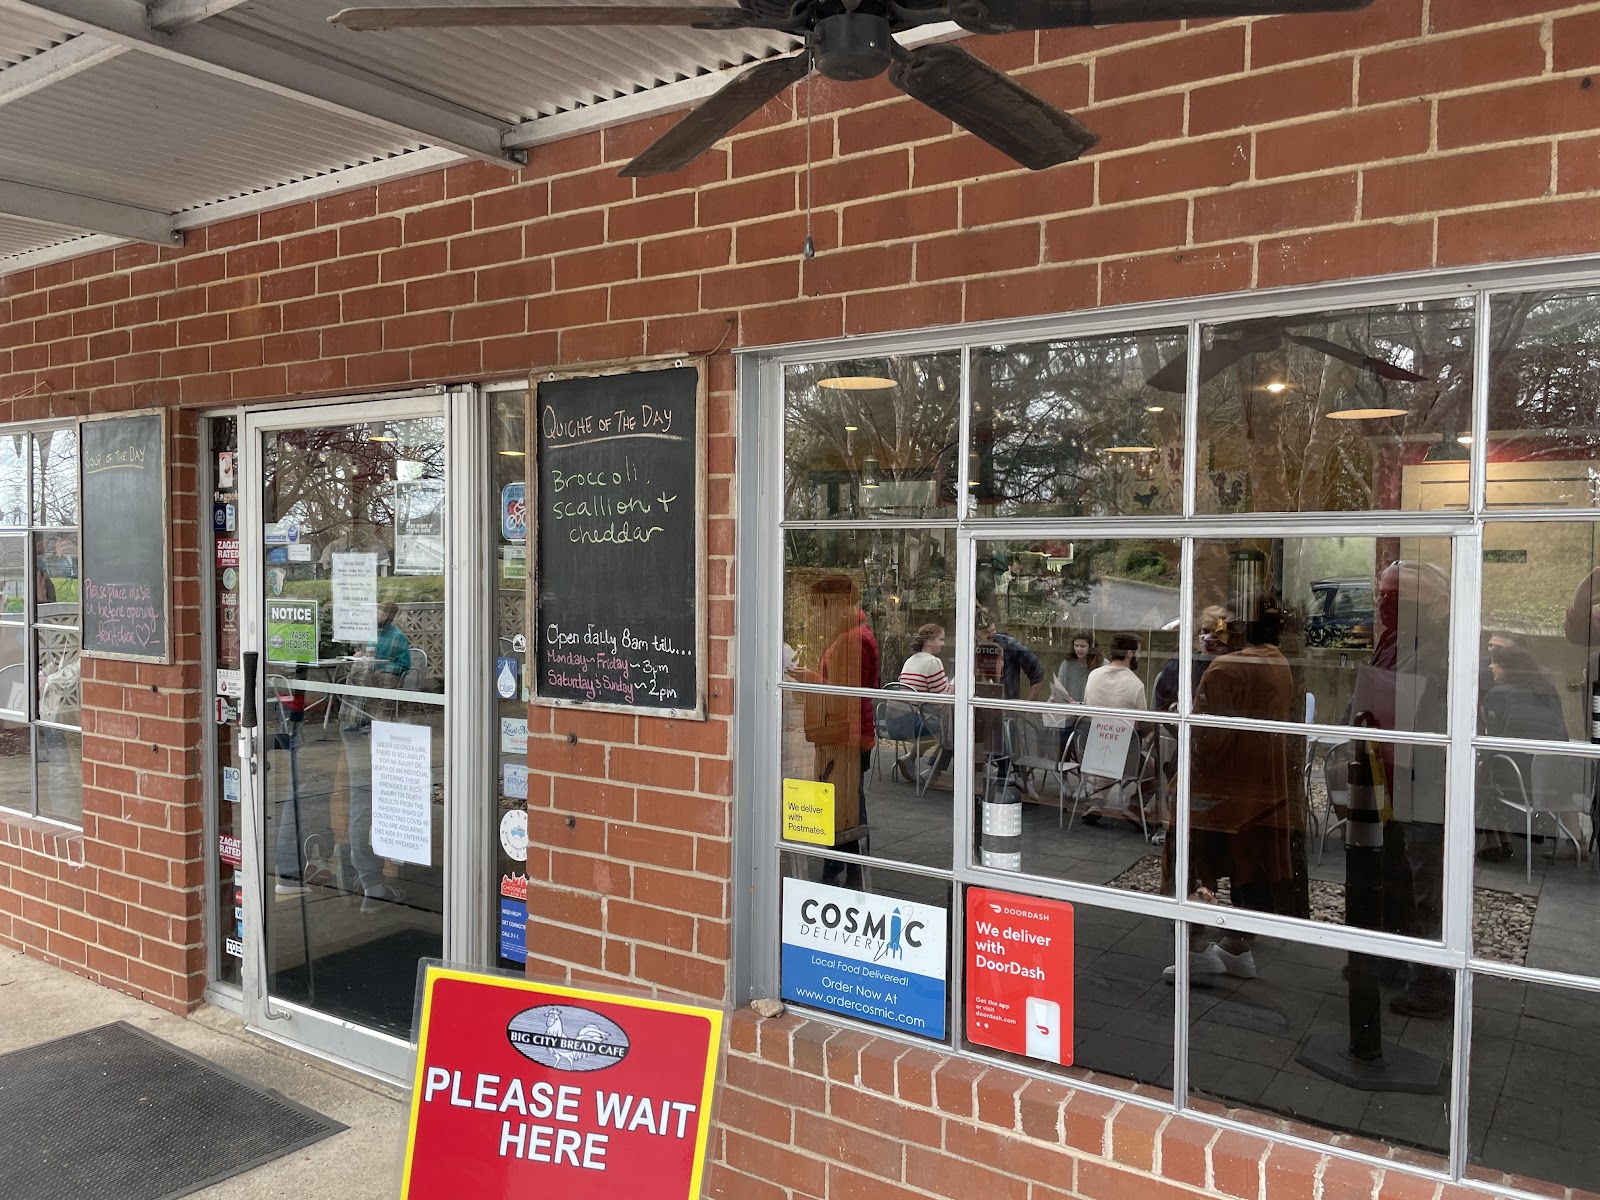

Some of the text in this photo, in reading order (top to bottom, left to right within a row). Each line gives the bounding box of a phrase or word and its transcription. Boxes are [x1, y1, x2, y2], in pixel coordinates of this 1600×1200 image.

[543, 404, 672, 438] QUICHE OF THE DAY
[84, 446, 146, 468] SOUP OF THE DAY
[552, 495, 650, 520] scallion
[570, 521, 664, 544] cheddar
[217, 541, 240, 549] ZAGAT
[217, 550, 240, 558] RATED
[84, 578, 106, 600] Please
[271, 607, 312, 620] NOTICE
[290, 631, 310, 641] MASKS
[546, 624, 580, 650] Open
[285, 639, 314, 650] REQUIRED
[498, 660, 515, 669] 2017
[642, 660, 669, 680] 3pm
[500, 682, 514, 692] blue
[548, 670, 596, 700] Saturday
[602, 675, 634, 704] Sunday
[648, 679, 678, 702] 2pm
[504, 723, 517, 736] Local
[1096, 723, 1114, 731] PICK
[1099, 732, 1120, 740] HERE
[381, 774, 404, 782] ENTERING
[403, 769, 429, 778] INDIVIDUAL
[380, 782, 403, 790] PREMISES
[378, 797, 399, 805] RESULTS
[378, 805, 401, 813] INHERENT
[788, 802, 823, 814] We deliver
[373, 812, 405, 823] CONTRACTING
[788, 813, 803, 822] with
[399, 825, 423, 834] ASSUMING
[788, 823, 826, 836] Postmates.
[219, 836, 241, 847] ZAGAT
[380, 837, 394, 845] THESE
[404, 834, 428, 843] ENTERING
[219, 845, 241, 857] RATED
[1004, 907, 1049, 921] DOORDASH
[509, 921, 526, 930] CONNECTE
[801, 899, 925, 952] COSMIC
[975, 920, 1051, 947] We deliver
[800, 924, 886, 961] DELIVERY
[975, 940, 1005, 955] with
[811, 955, 909, 986] Local Food Delivered!
[976, 954, 1045, 981] DoorDash
[821, 977, 897, 1005] Order Now At
[976, 996, 987, 1004] Get
[796, 987, 925, 1029] www.ordercosmic.com
[976, 1010, 1017, 1024] doordash.com
[510, 1032, 625, 1057] BIG CITY BREAD CAFE
[424, 1066, 697, 1139] PLEASE WAIT
[499, 1120, 610, 1171] HERE
